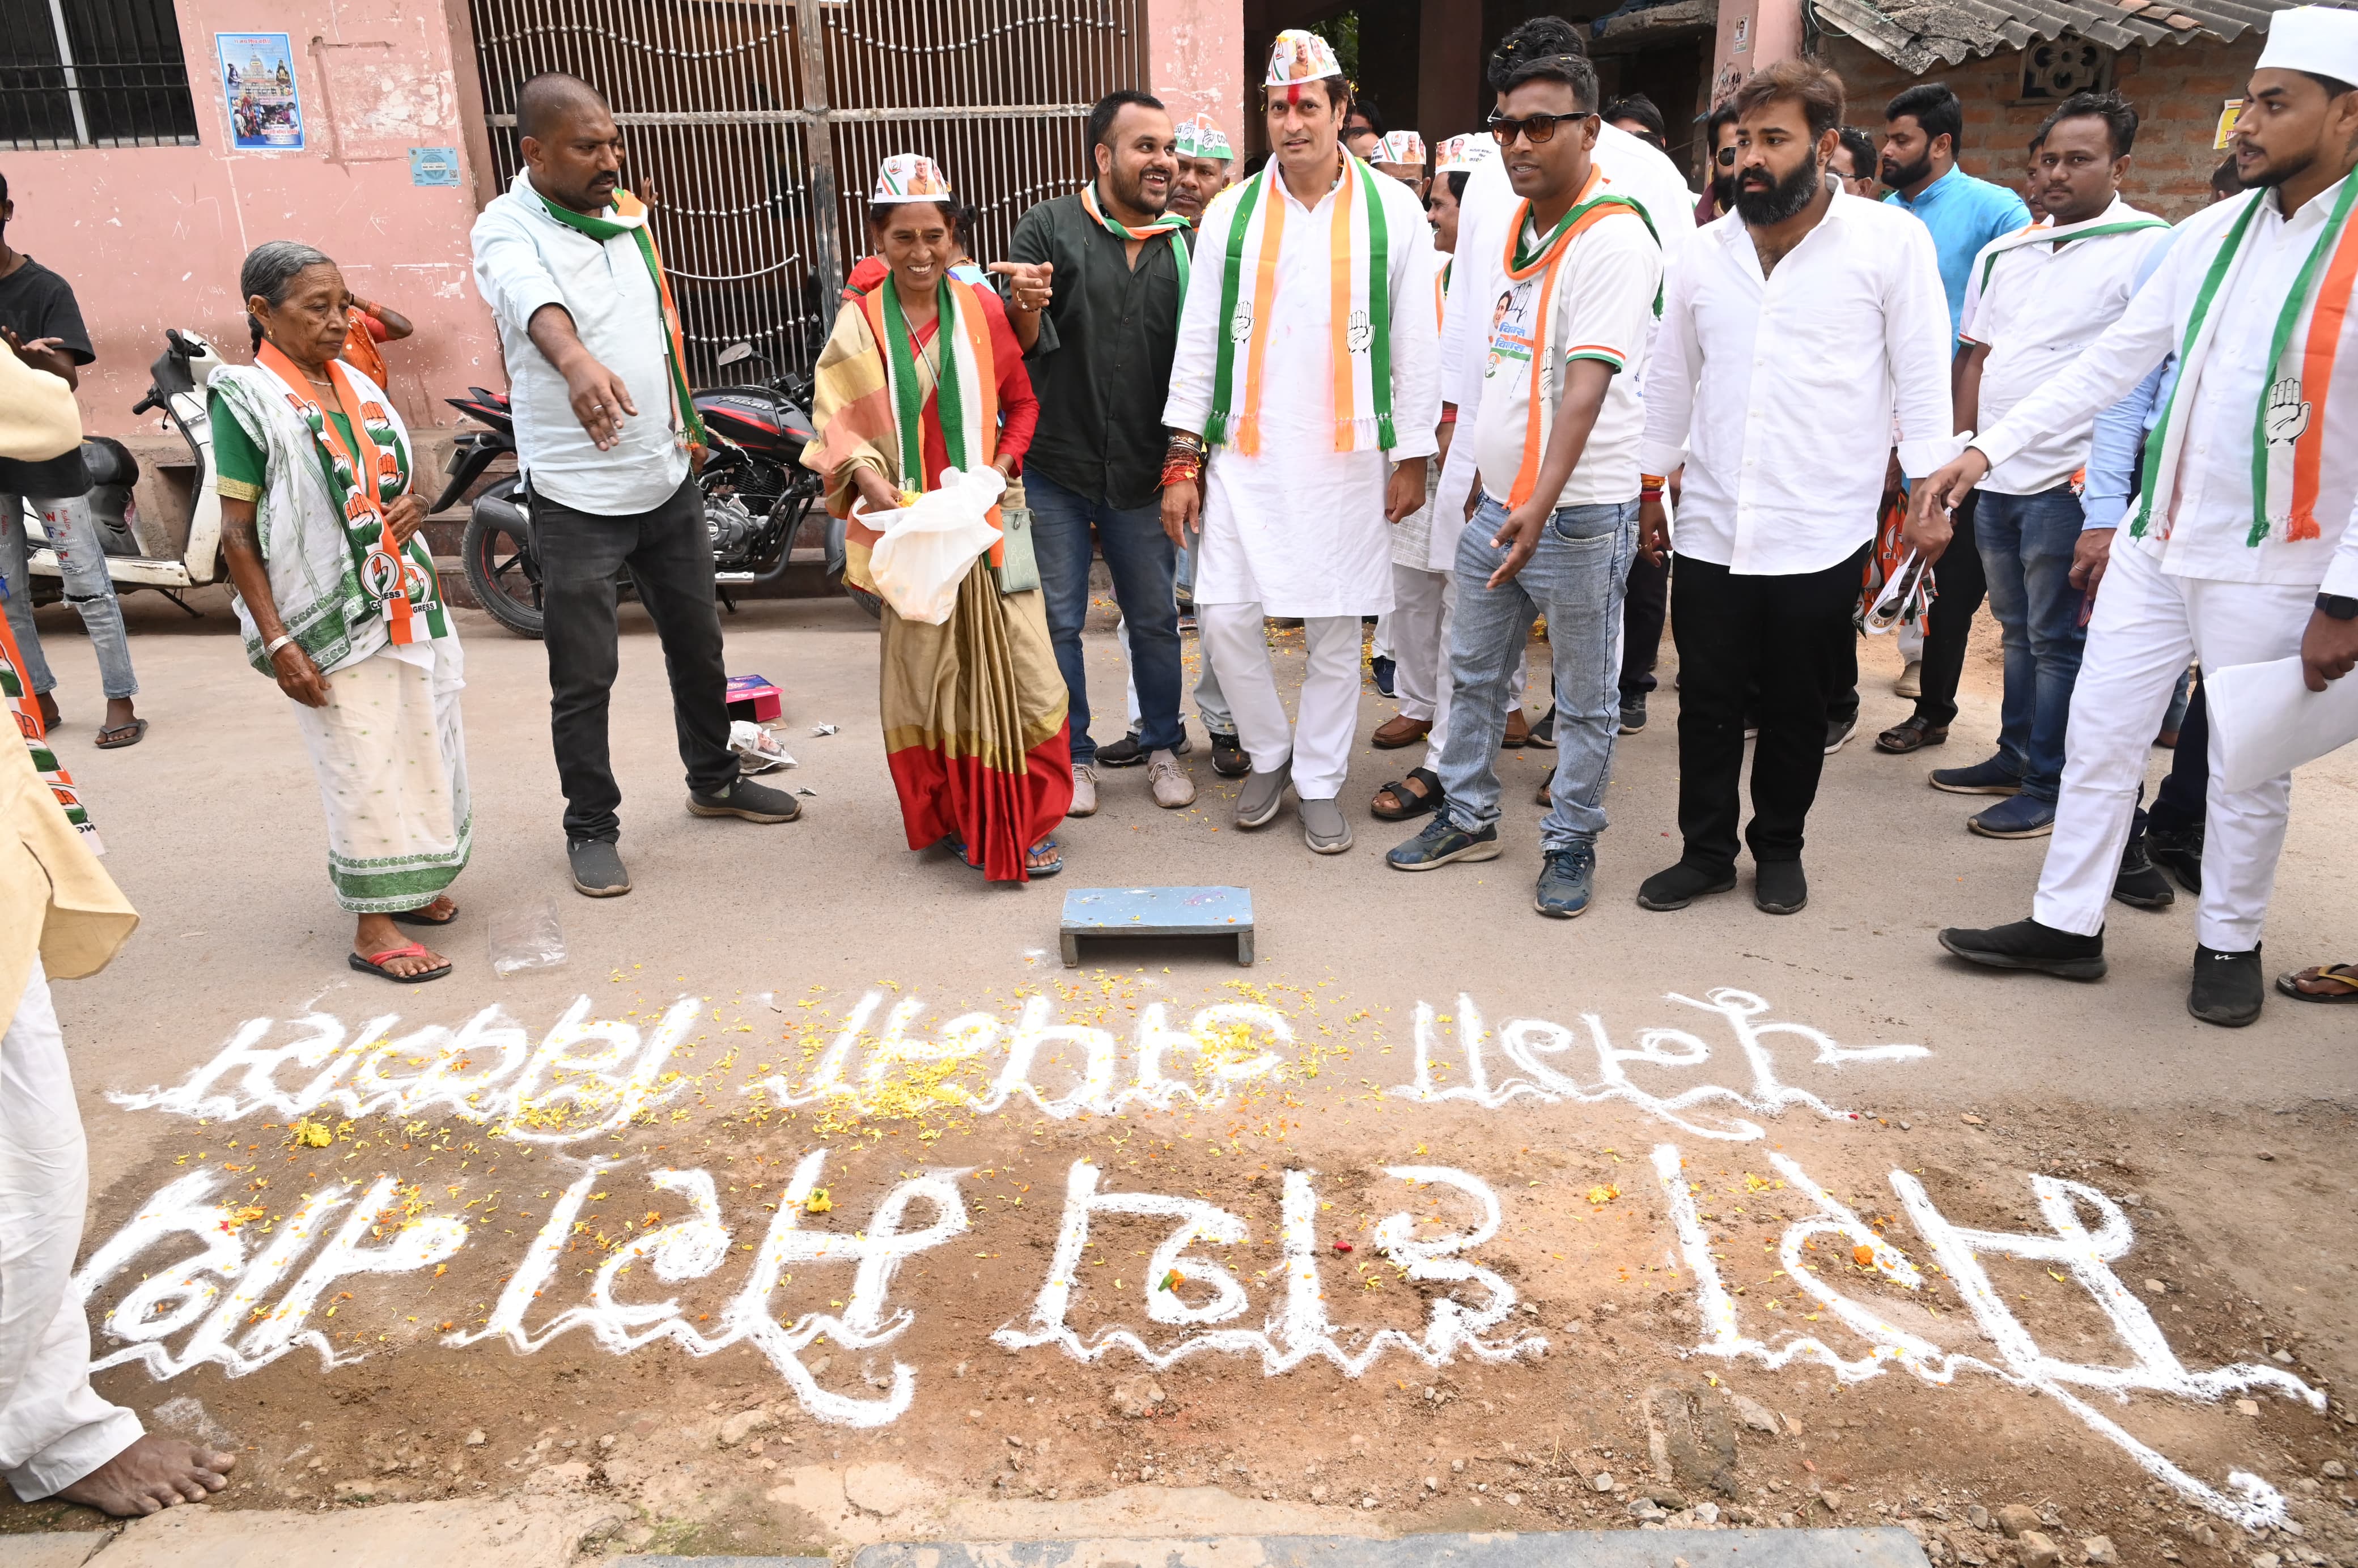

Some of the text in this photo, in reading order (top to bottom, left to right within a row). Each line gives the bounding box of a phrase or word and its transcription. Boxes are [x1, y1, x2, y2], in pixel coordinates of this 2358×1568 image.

[105, 995, 700, 1144] विकास
[738, 992, 1294, 1120] अपना
[439, 1148, 972, 1428] मेरा
[992, 1158, 1546, 1378] हाथ
[1651, 1143, 2327, 1532] मेरा
